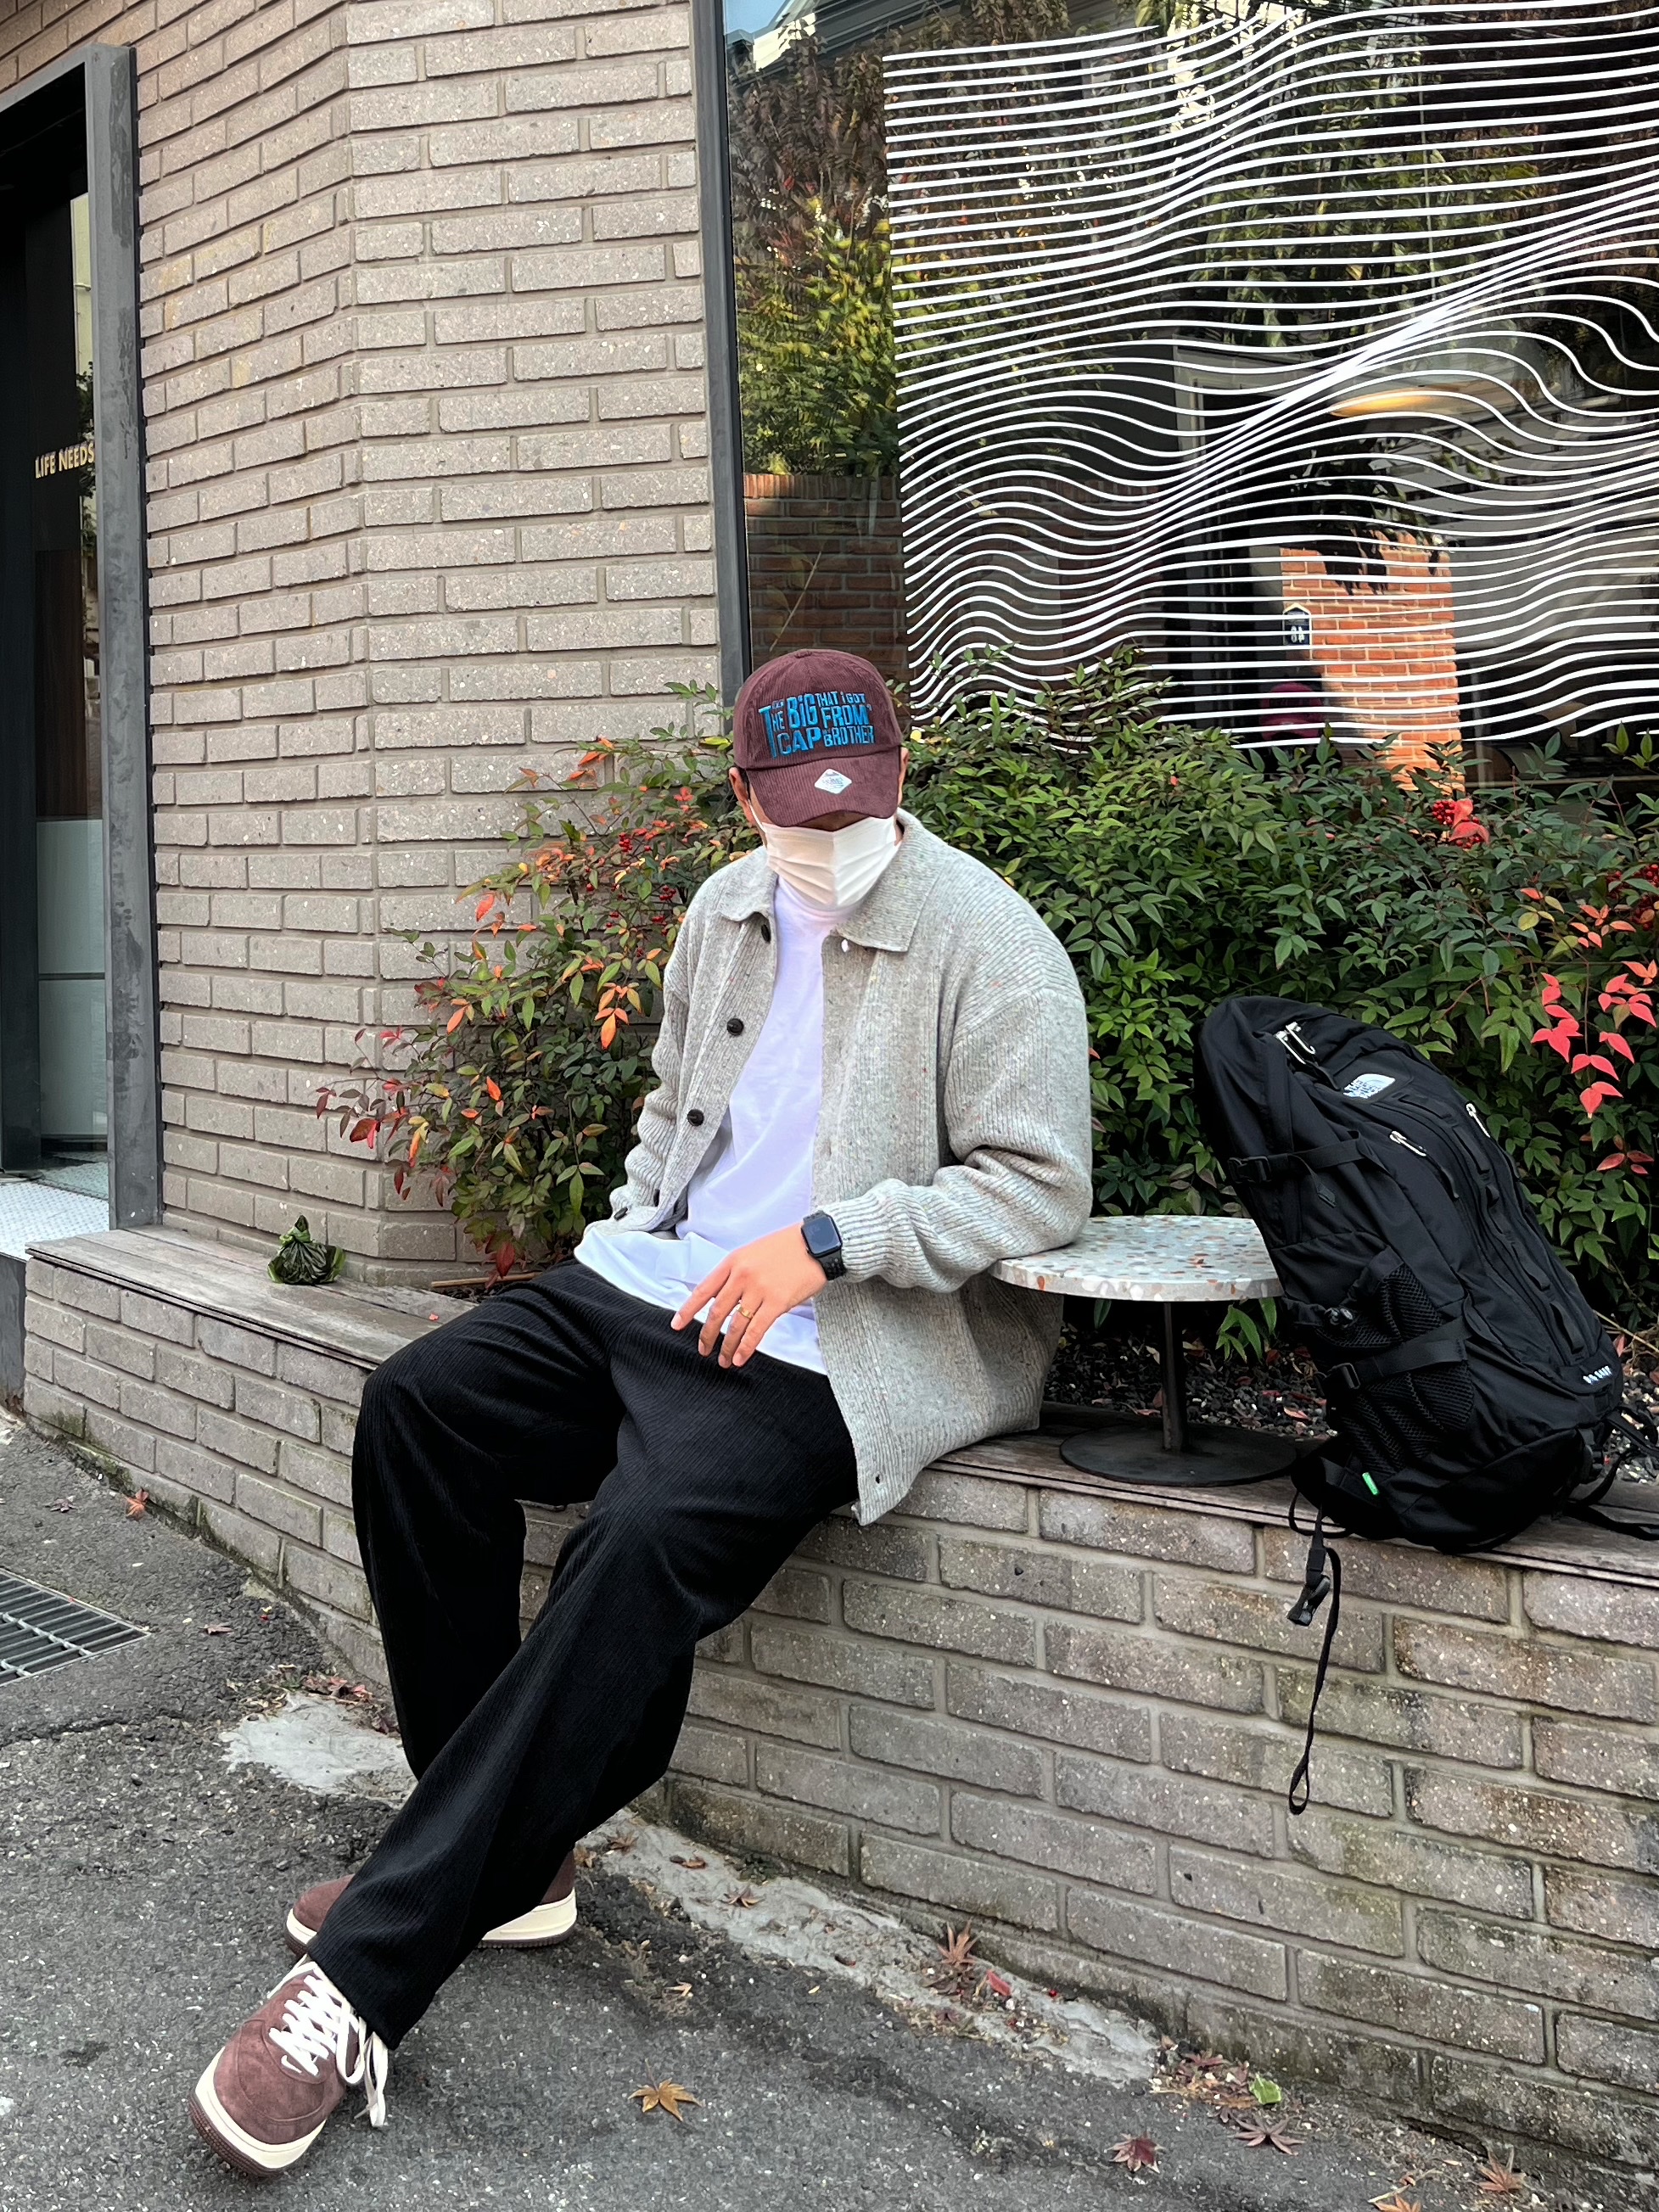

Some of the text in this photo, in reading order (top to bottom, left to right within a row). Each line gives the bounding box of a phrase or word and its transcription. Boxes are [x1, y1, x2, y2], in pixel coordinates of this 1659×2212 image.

[35, 441, 94, 479] LIFE NEEDS
[815, 691, 838, 708] THAT
[846, 692, 866, 704] GOT
[821, 703, 870, 729] FROM
[776, 726, 822, 754] CAP
[823, 725, 875, 748] BROTHER
